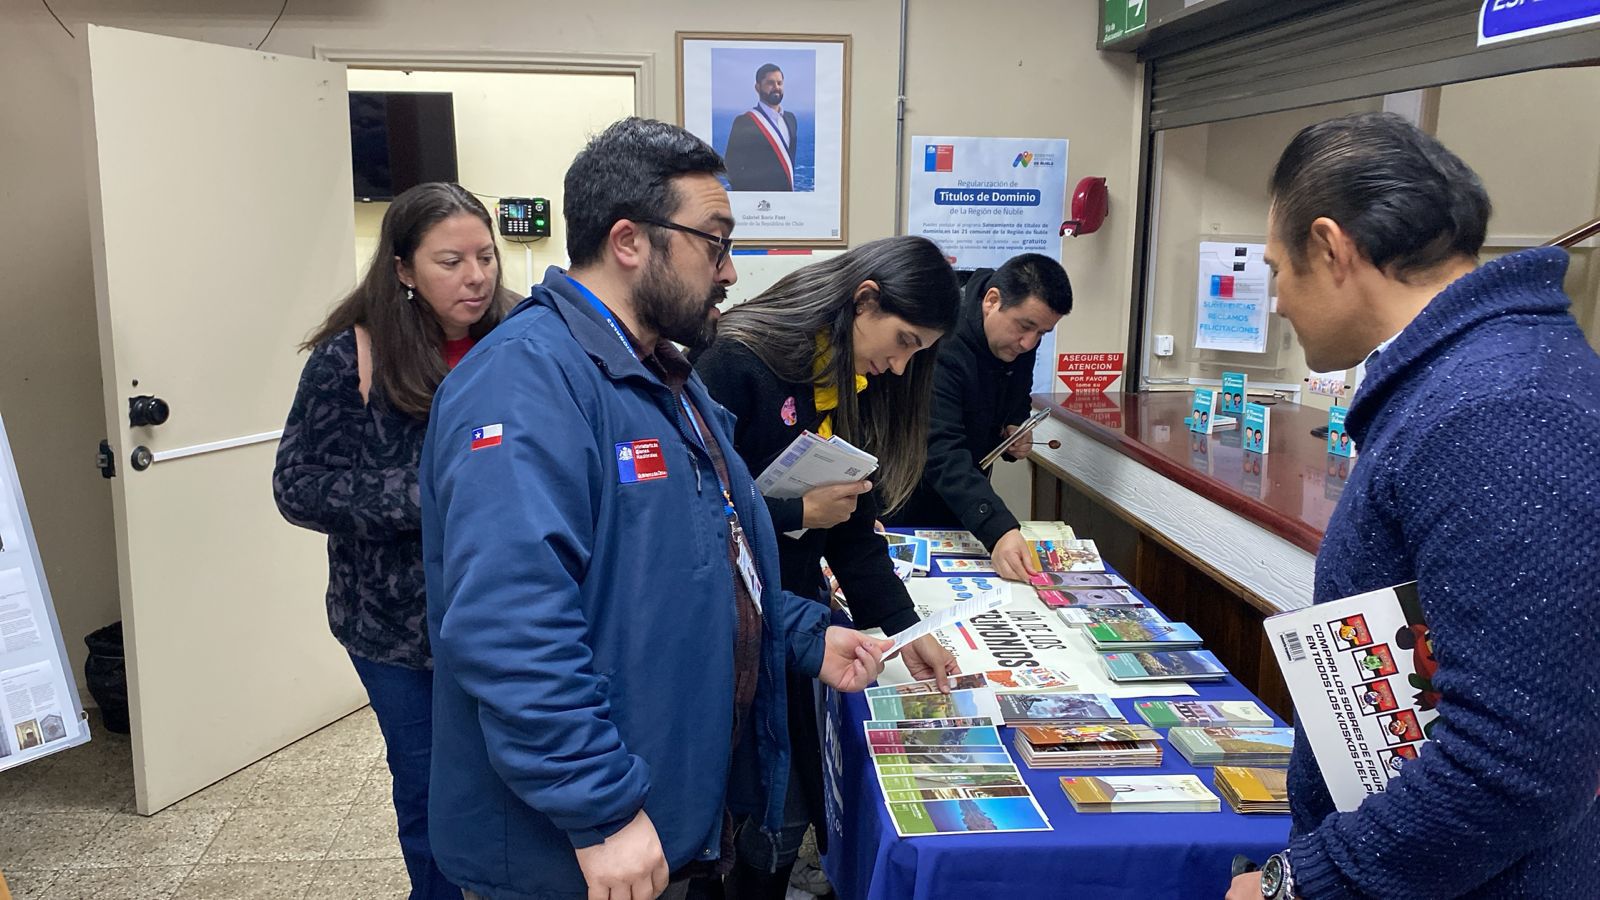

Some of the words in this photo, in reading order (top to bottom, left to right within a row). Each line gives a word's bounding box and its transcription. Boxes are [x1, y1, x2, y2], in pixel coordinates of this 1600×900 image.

[958, 180, 1008, 188] Regularización
[940, 192, 974, 201] Títulos
[977, 192, 990, 201] de
[992, 192, 1036, 202] Dominio
[968, 208, 991, 216] Región
[1003, 208, 1024, 216] Ñuble
[1208, 312, 1248, 322] RECLAMOS
[1200, 323, 1259, 334] FELICITACIONES
[1016, 624, 1053, 632] DE
[1025, 635, 1067, 649] LOS
[1313, 624, 1337, 672] COMPRA
[1332, 674, 1346, 695] LOS
[1341, 697, 1364, 740] SOBRES
[1359, 743, 1371, 758] DE
[1306, 636, 1318, 651] EN
[1313, 652, 1331, 687] TODOS
[1327, 690, 1340, 710] LOS
[1335, 712, 1359, 758] KIOSKOS
[1354, 761, 1367, 782] DEL
